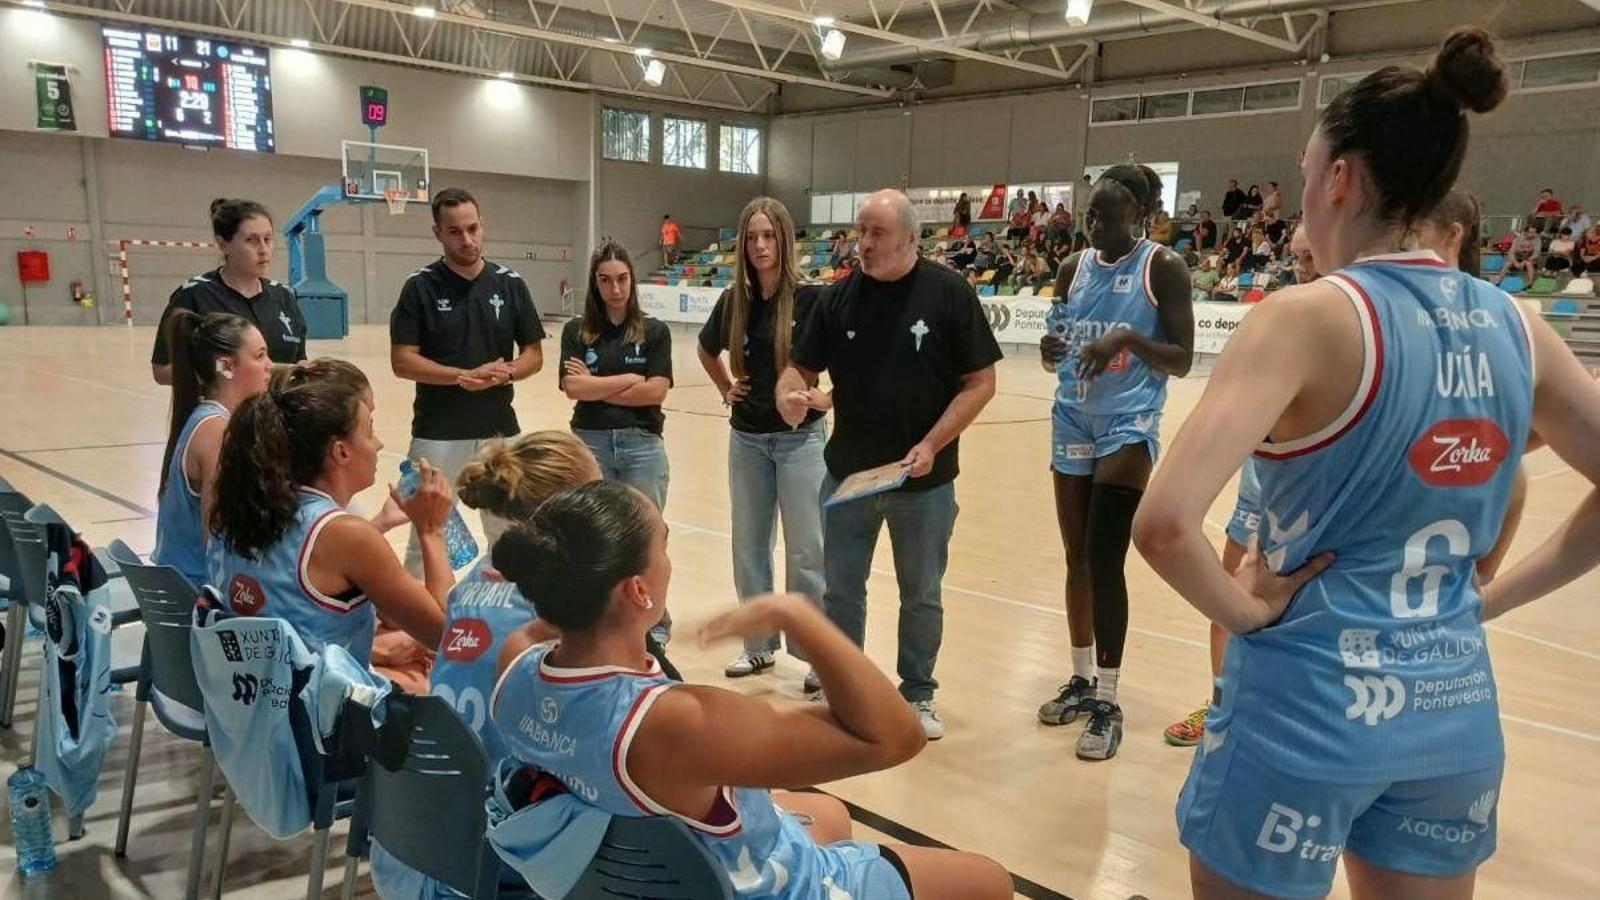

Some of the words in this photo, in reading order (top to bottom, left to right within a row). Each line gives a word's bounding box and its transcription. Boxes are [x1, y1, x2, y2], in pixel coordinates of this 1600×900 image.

[165, 35, 178, 51] 11
[196, 40, 211, 56] 21
[47, 80, 60, 99] 5
[203, 111, 212, 124] 2
[368, 104, 385, 121] 09
[1015, 308, 1046, 320] Deput
[1198, 319, 1211, 329] co
[1436, 345, 1494, 398] UXÍA
[1430, 435, 1492, 472] Zorka
[1390, 519, 1471, 618] 6
[447, 628, 480, 652] Zorka
[1390, 620, 1451, 649] XUNTA
[245, 646, 262, 660] DE
[1383, 648, 1410, 665] DE
[1413, 637, 1484, 664] GALICIA
[1414, 670, 1488, 695] Deputación
[1413, 686, 1492, 711] Pontevedra
